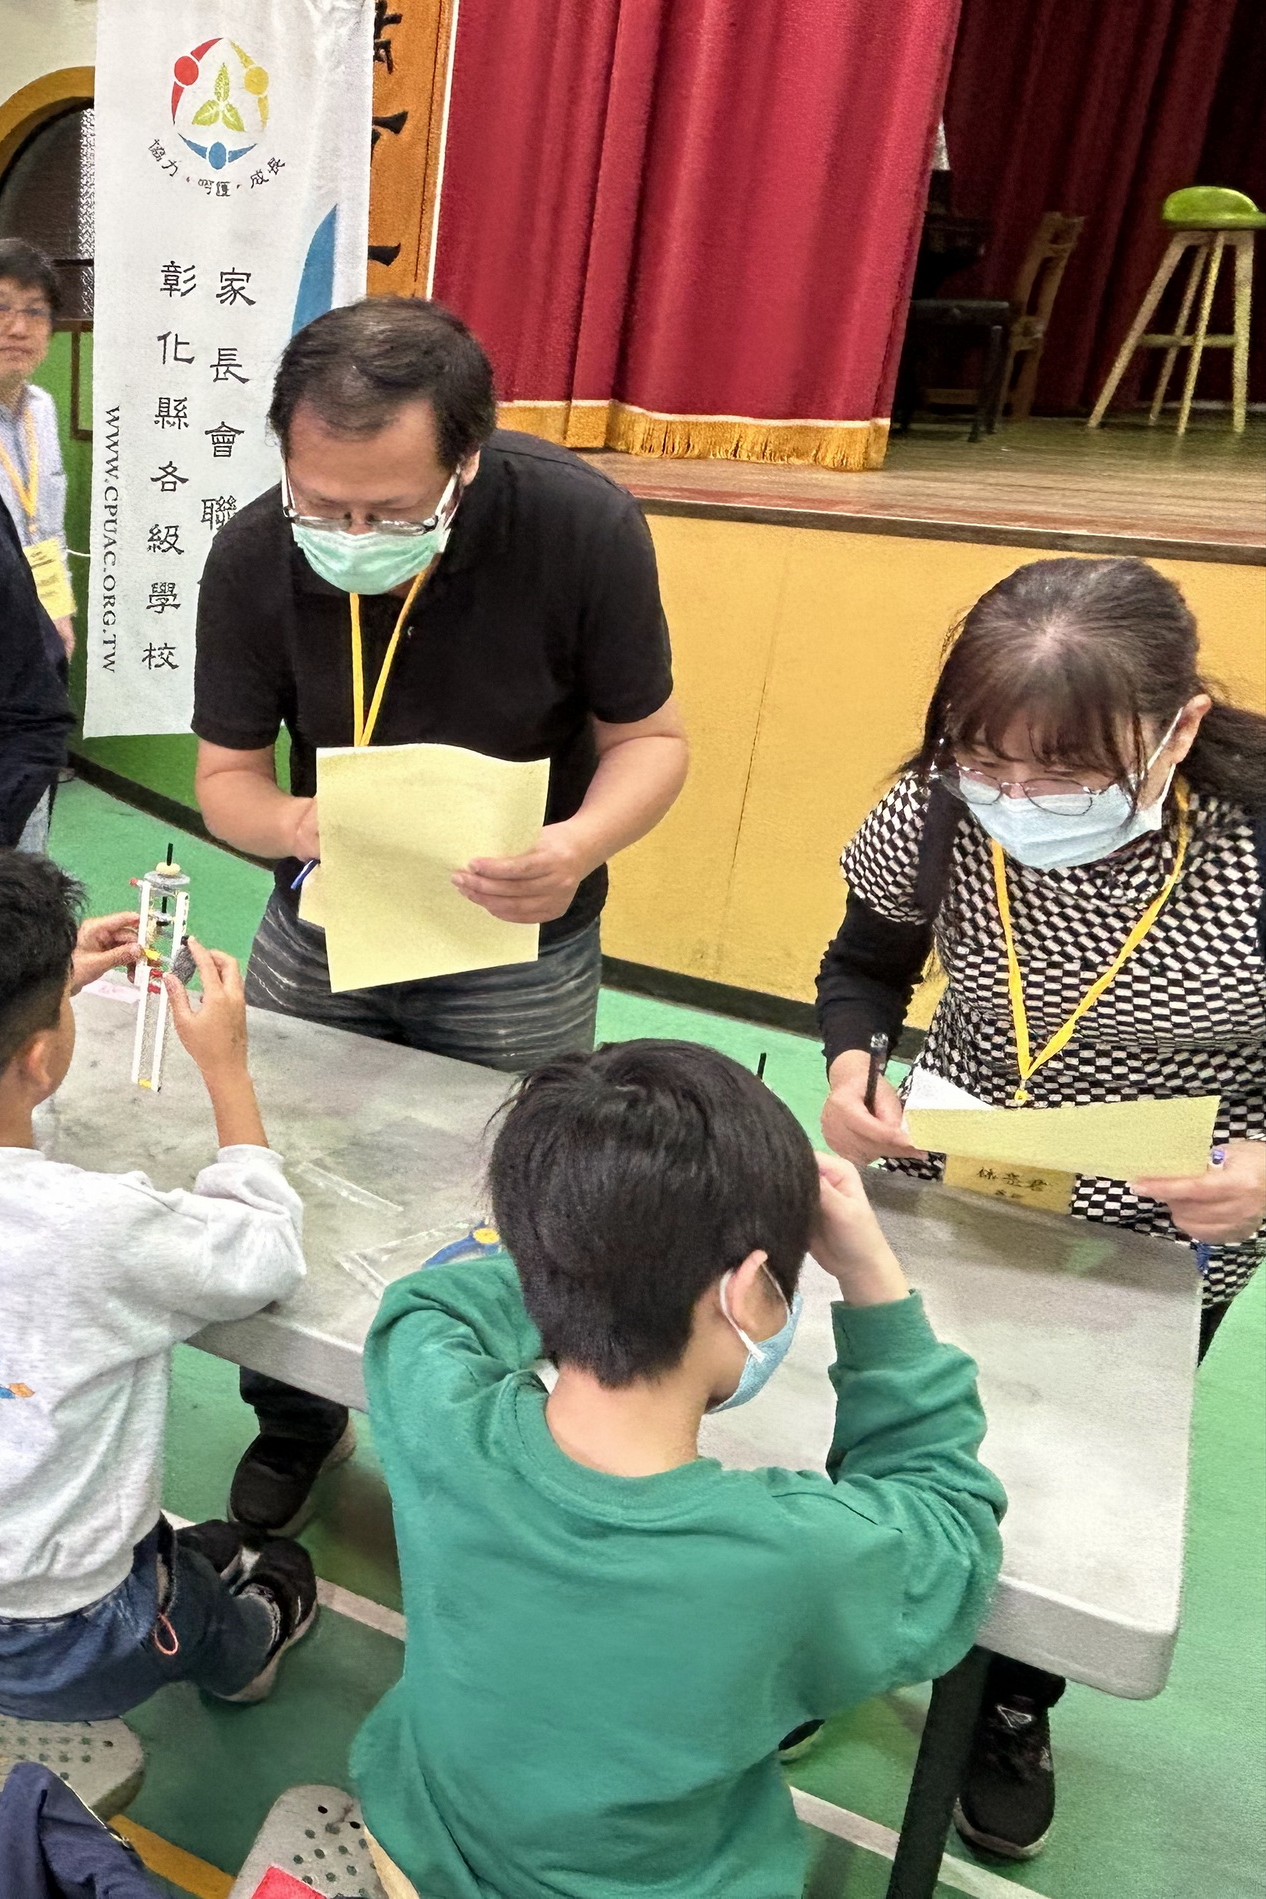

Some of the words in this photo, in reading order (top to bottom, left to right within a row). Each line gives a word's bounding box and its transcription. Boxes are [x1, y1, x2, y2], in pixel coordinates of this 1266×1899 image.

[101, 405, 121, 674] WWW.CPUAC.ORG.TW
[141, 260, 197, 671] 彰化縣各級學校
